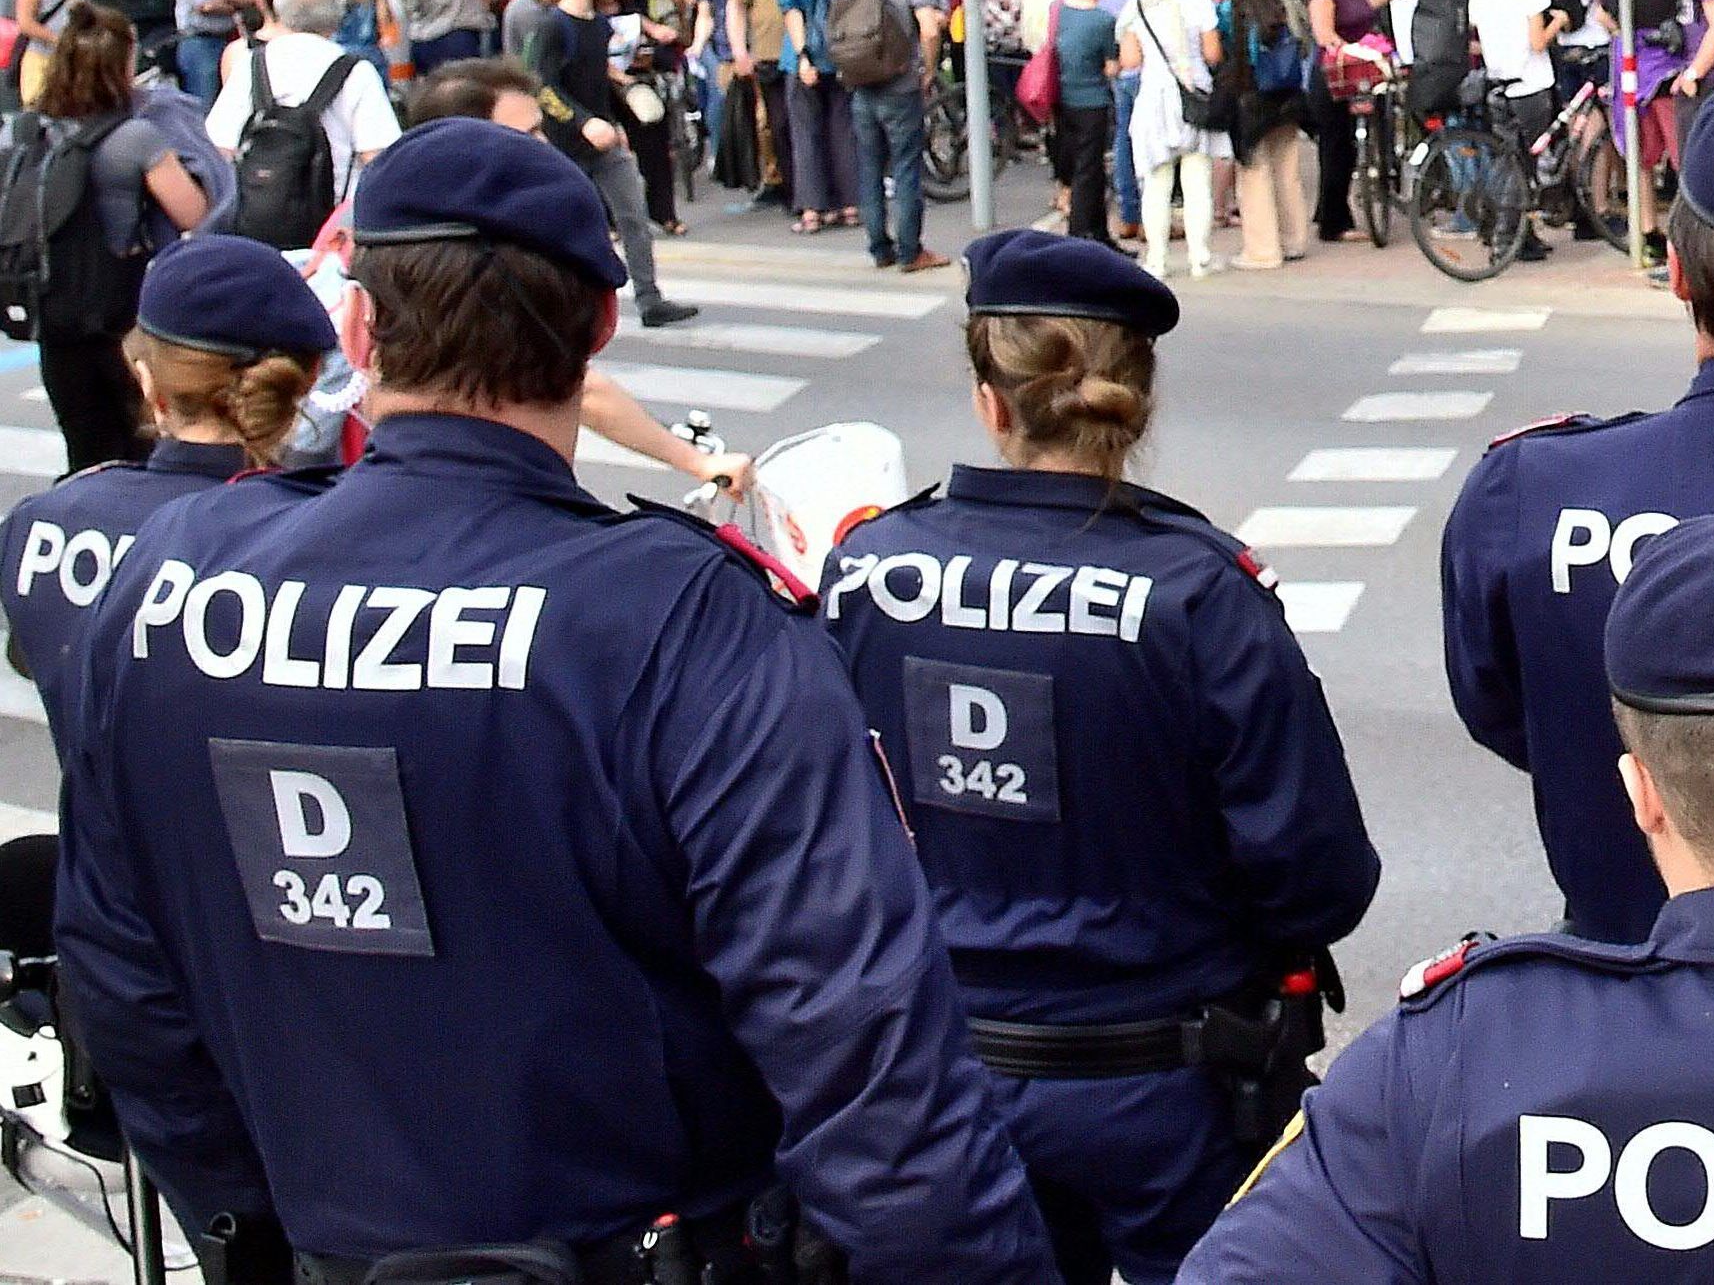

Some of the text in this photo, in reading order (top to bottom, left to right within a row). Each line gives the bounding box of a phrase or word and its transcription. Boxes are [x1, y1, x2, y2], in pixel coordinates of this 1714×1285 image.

[17, 520, 136, 607] PO
[826, 552, 1153, 643] POLIZEI
[133, 559, 547, 690] POLIZEI
[949, 684, 1007, 750] D
[269, 770, 351, 858] D
[938, 754, 1027, 804] 342
[273, 869, 391, 930] 342
